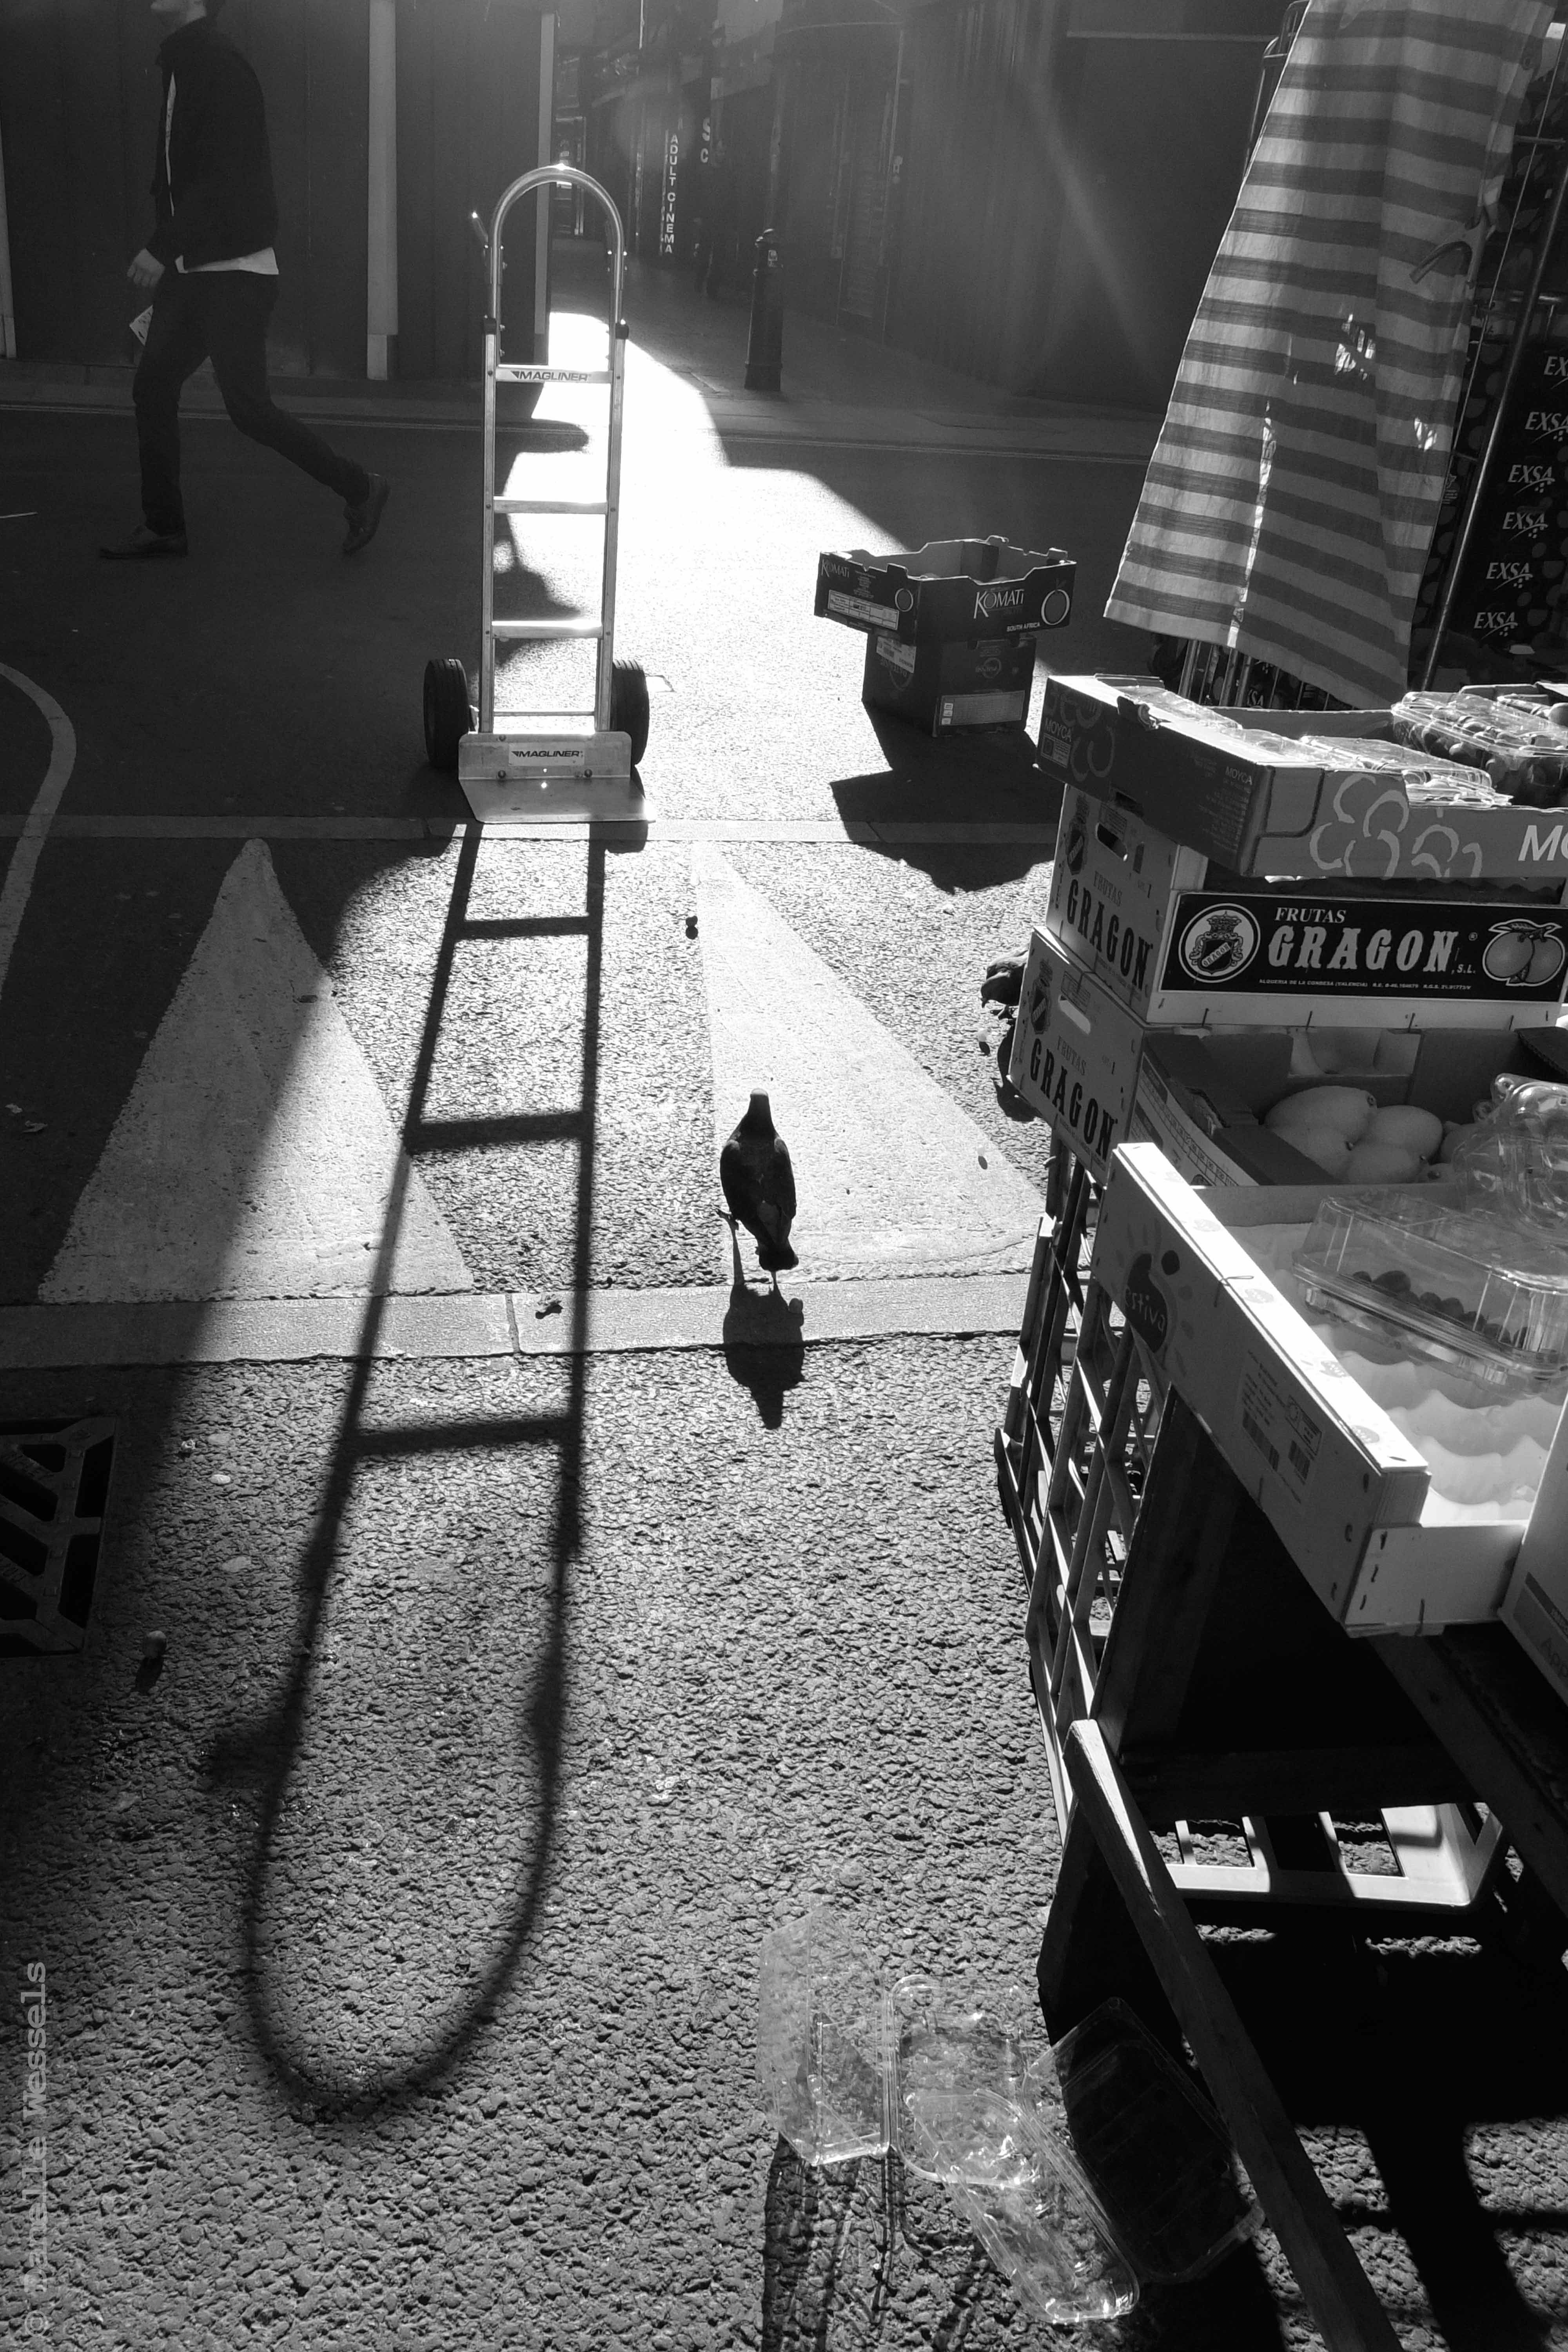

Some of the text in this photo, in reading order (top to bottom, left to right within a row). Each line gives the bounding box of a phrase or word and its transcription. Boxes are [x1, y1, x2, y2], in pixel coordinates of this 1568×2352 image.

[664, 134, 679, 253] ADULT CINEMA
[519, 371, 588, 381] MAGLINER
[1543, 356, 1568, 376] EX
[1508, 464, 1553, 485] EXSA
[1502, 512, 1545, 530] EXSA
[821, 559, 849, 577] KOMATI
[1486, 562, 1530, 580] EXSA
[973, 589, 1025, 619] KOMATI
[1474, 612, 1515, 629] EXSA
[1044, 717, 1072, 742] MOYCA
[1225, 766, 1252, 785] MOYCA
[1275, 907, 1346, 923] FRUTAS
[1067, 878, 1154, 991] GRAGON
[1268, 925, 1459, 972] GRAGON
[1030, 1038, 1118, 1161] GRAGON
